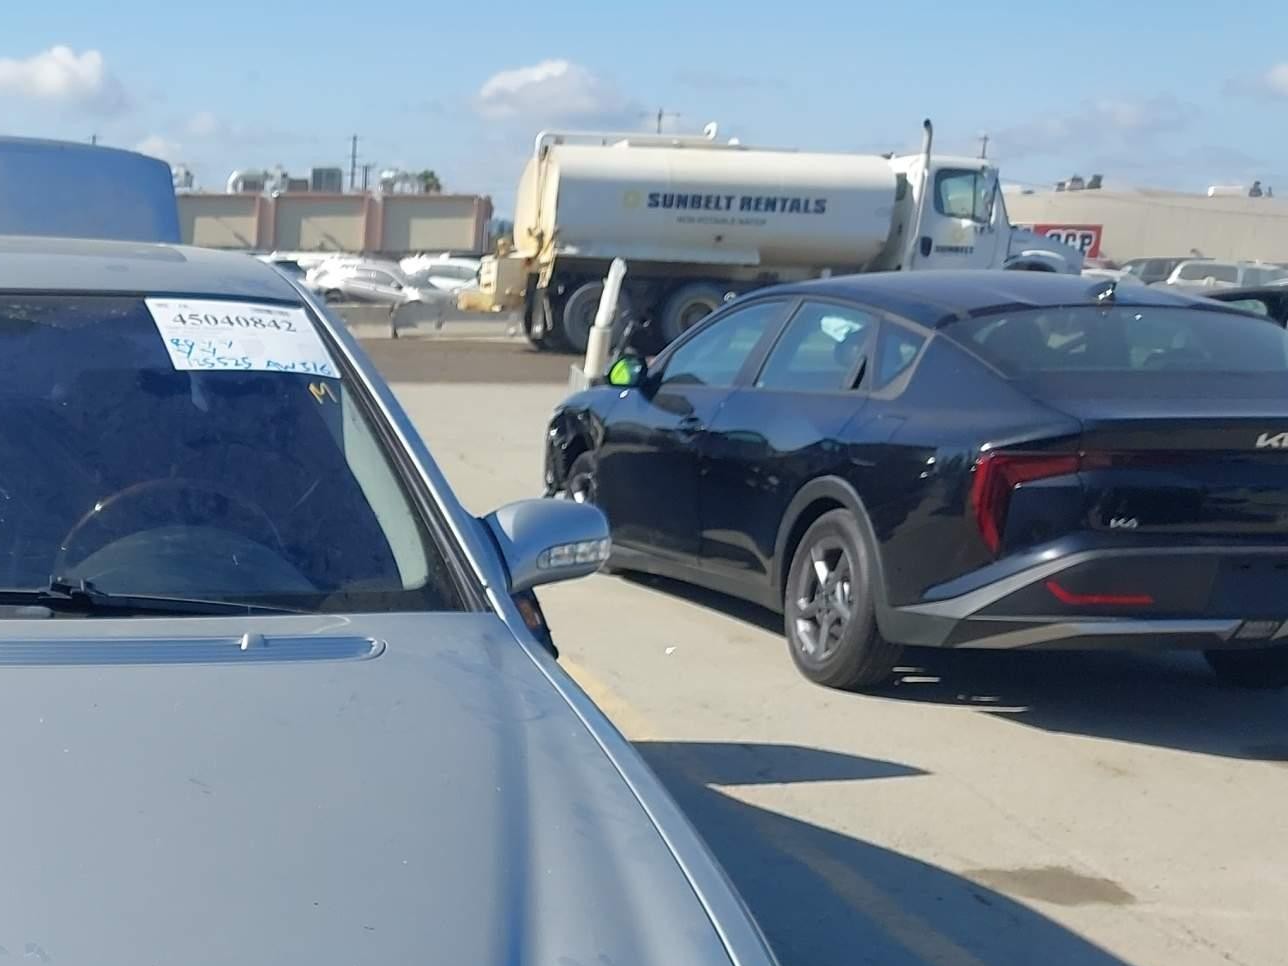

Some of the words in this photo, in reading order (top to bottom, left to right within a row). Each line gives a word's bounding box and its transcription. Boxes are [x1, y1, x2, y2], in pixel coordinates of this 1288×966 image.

[647, 192, 735, 212] SUNBELT
[739, 195, 827, 214] RENTALS
[172, 312, 297, 333] 45040842
[309, 381, 338, 405] M
